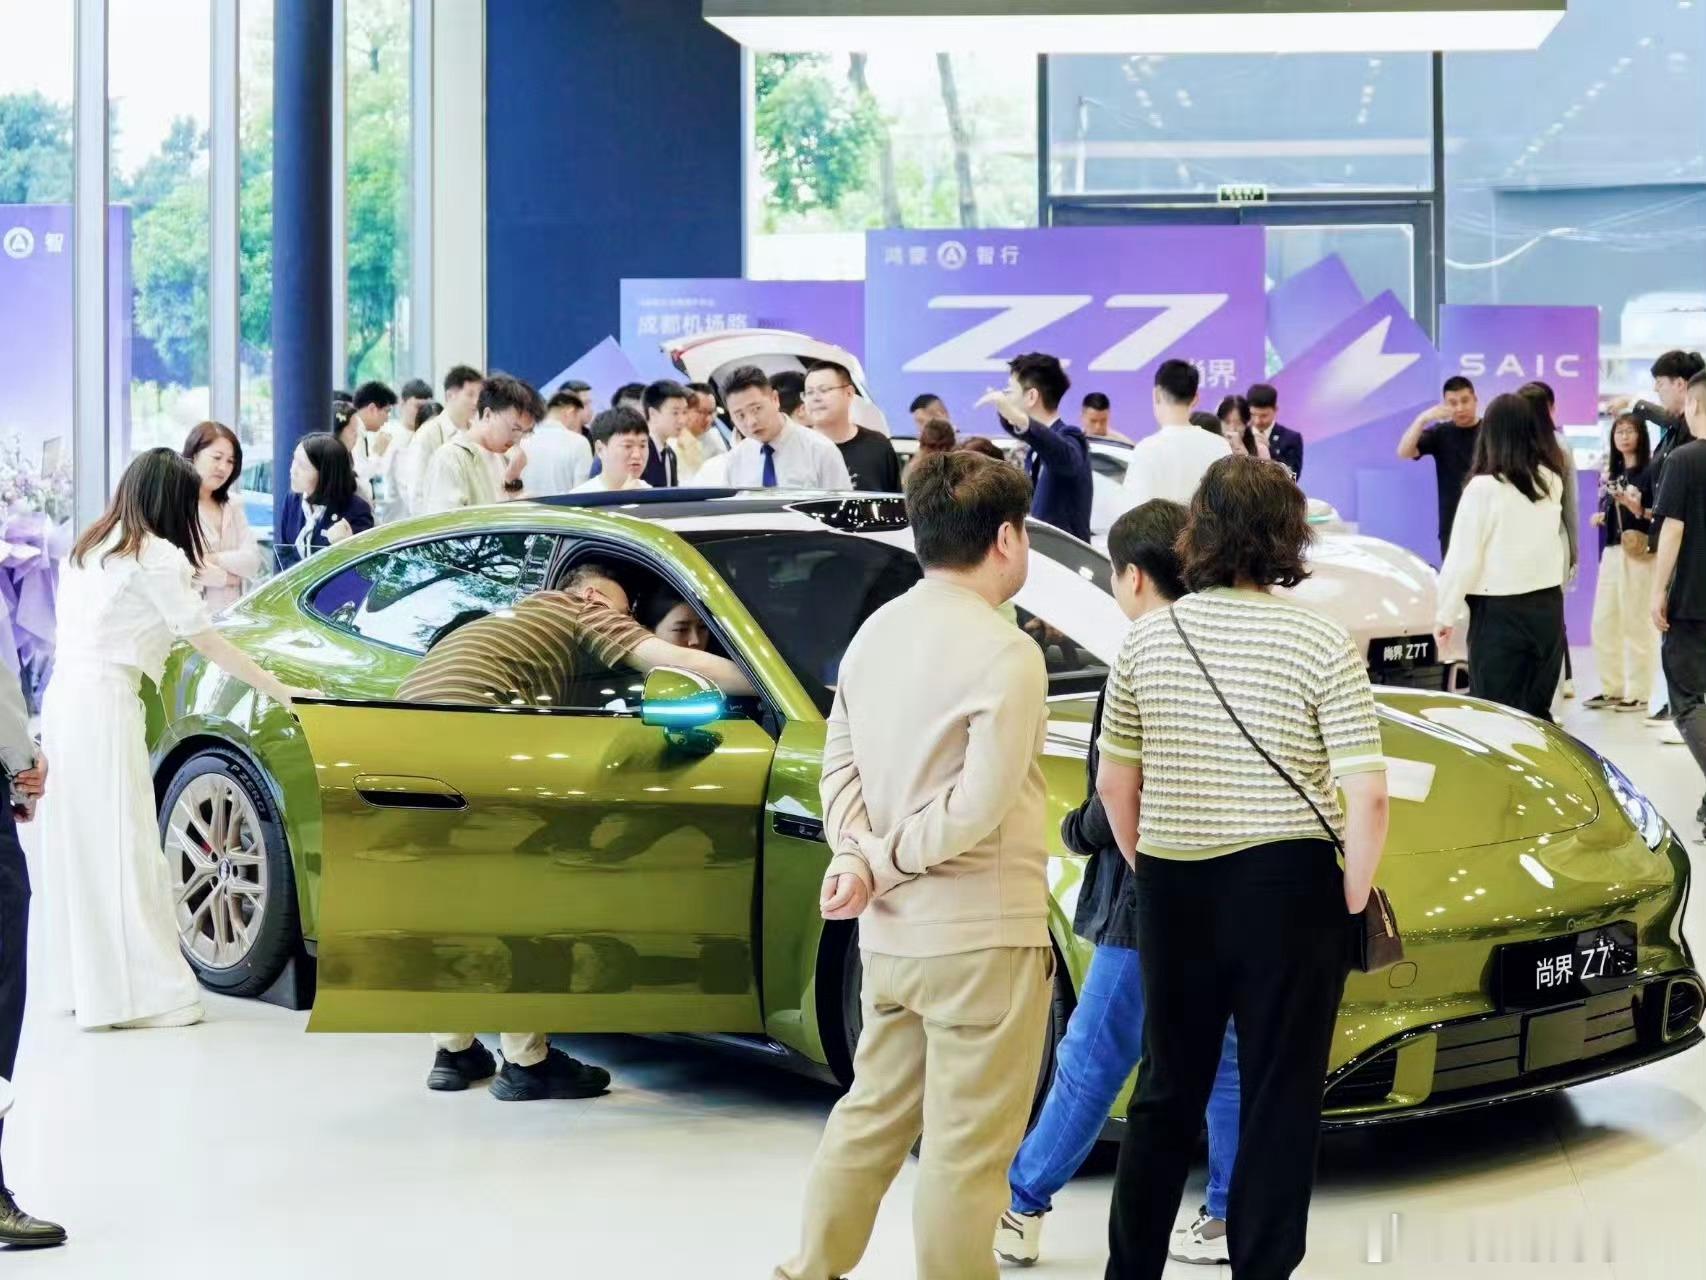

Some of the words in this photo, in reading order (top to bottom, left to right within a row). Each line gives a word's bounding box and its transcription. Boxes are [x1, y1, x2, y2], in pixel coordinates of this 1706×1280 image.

[901, 293, 1230, 373] Z7
[1459, 353, 1580, 378] SAIC
[1405, 642, 1429, 660] Z7T
[239, 772, 267, 813] ZERO
[1536, 953, 1574, 991] 尚界
[1580, 945, 1610, 980] Z7
